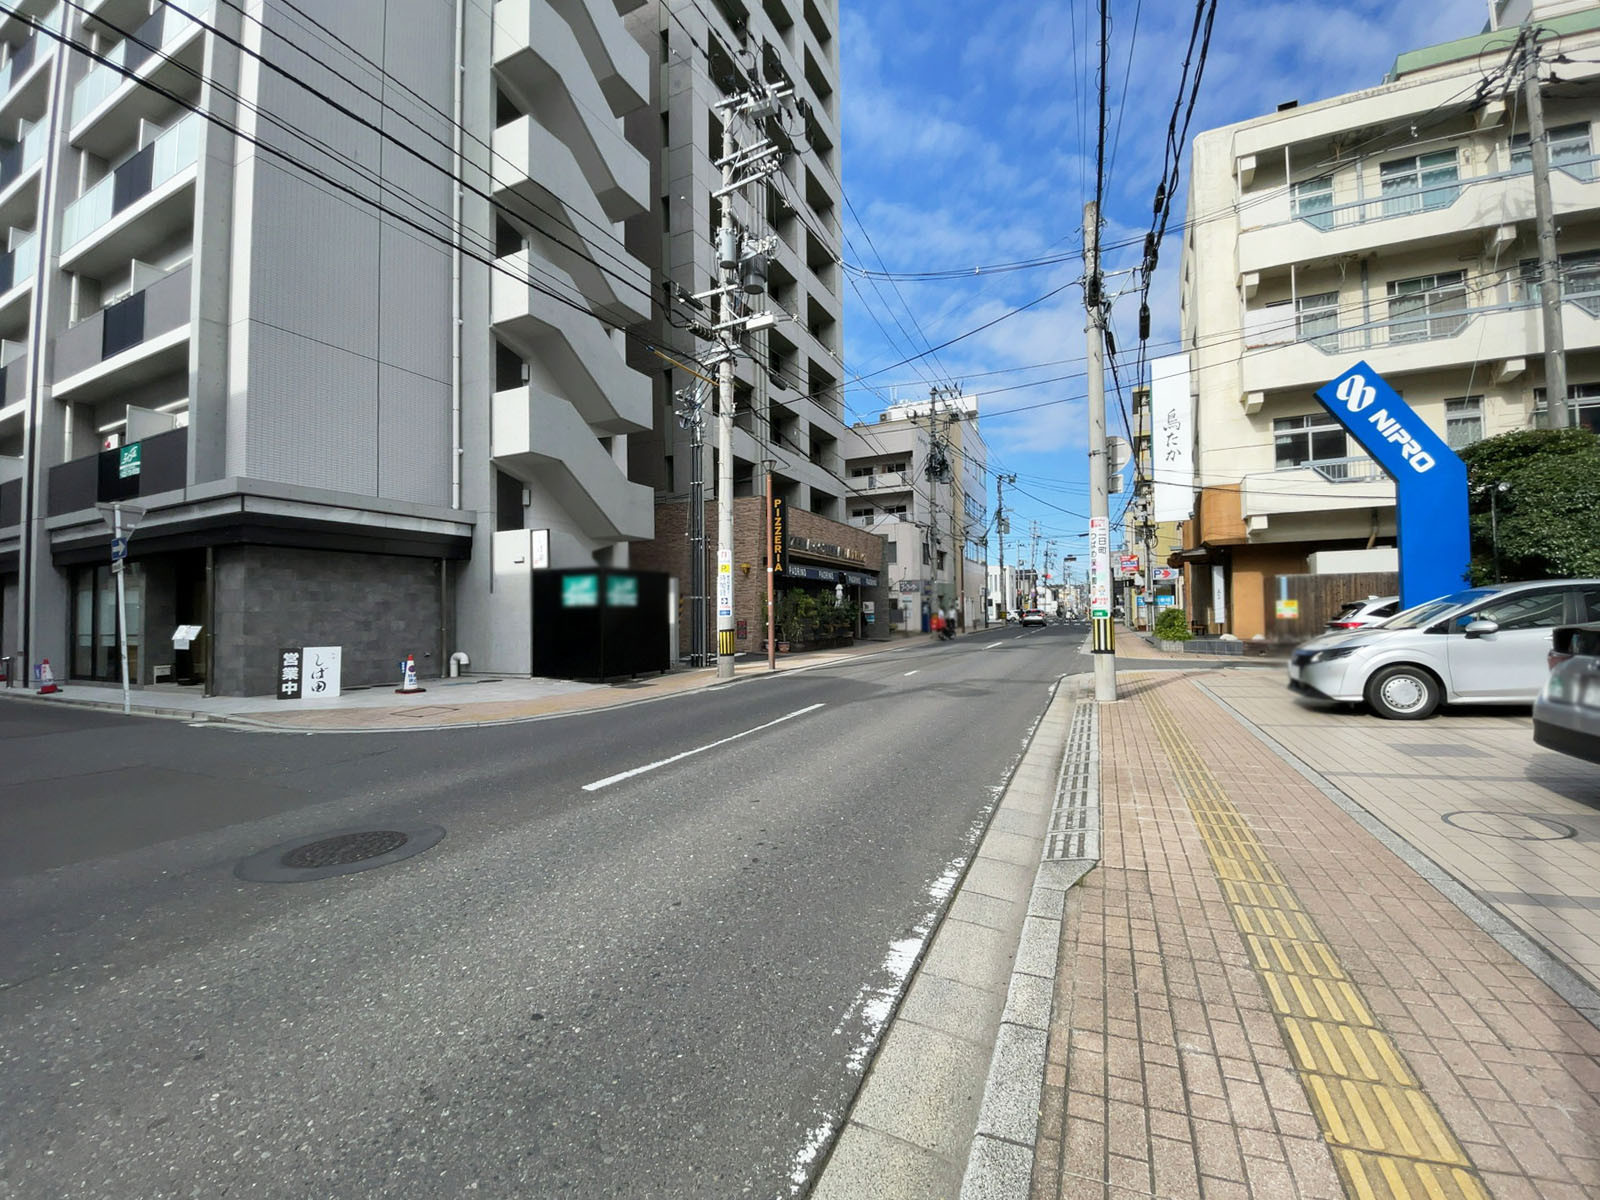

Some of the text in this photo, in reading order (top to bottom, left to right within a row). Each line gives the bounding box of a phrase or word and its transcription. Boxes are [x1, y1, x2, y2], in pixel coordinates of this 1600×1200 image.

[1368, 408, 1436, 474] NIPRO
[774, 499, 783, 572] PIZZERIA
[1154, 569, 1161, 578] P
[281, 652, 300, 695] 営業中
